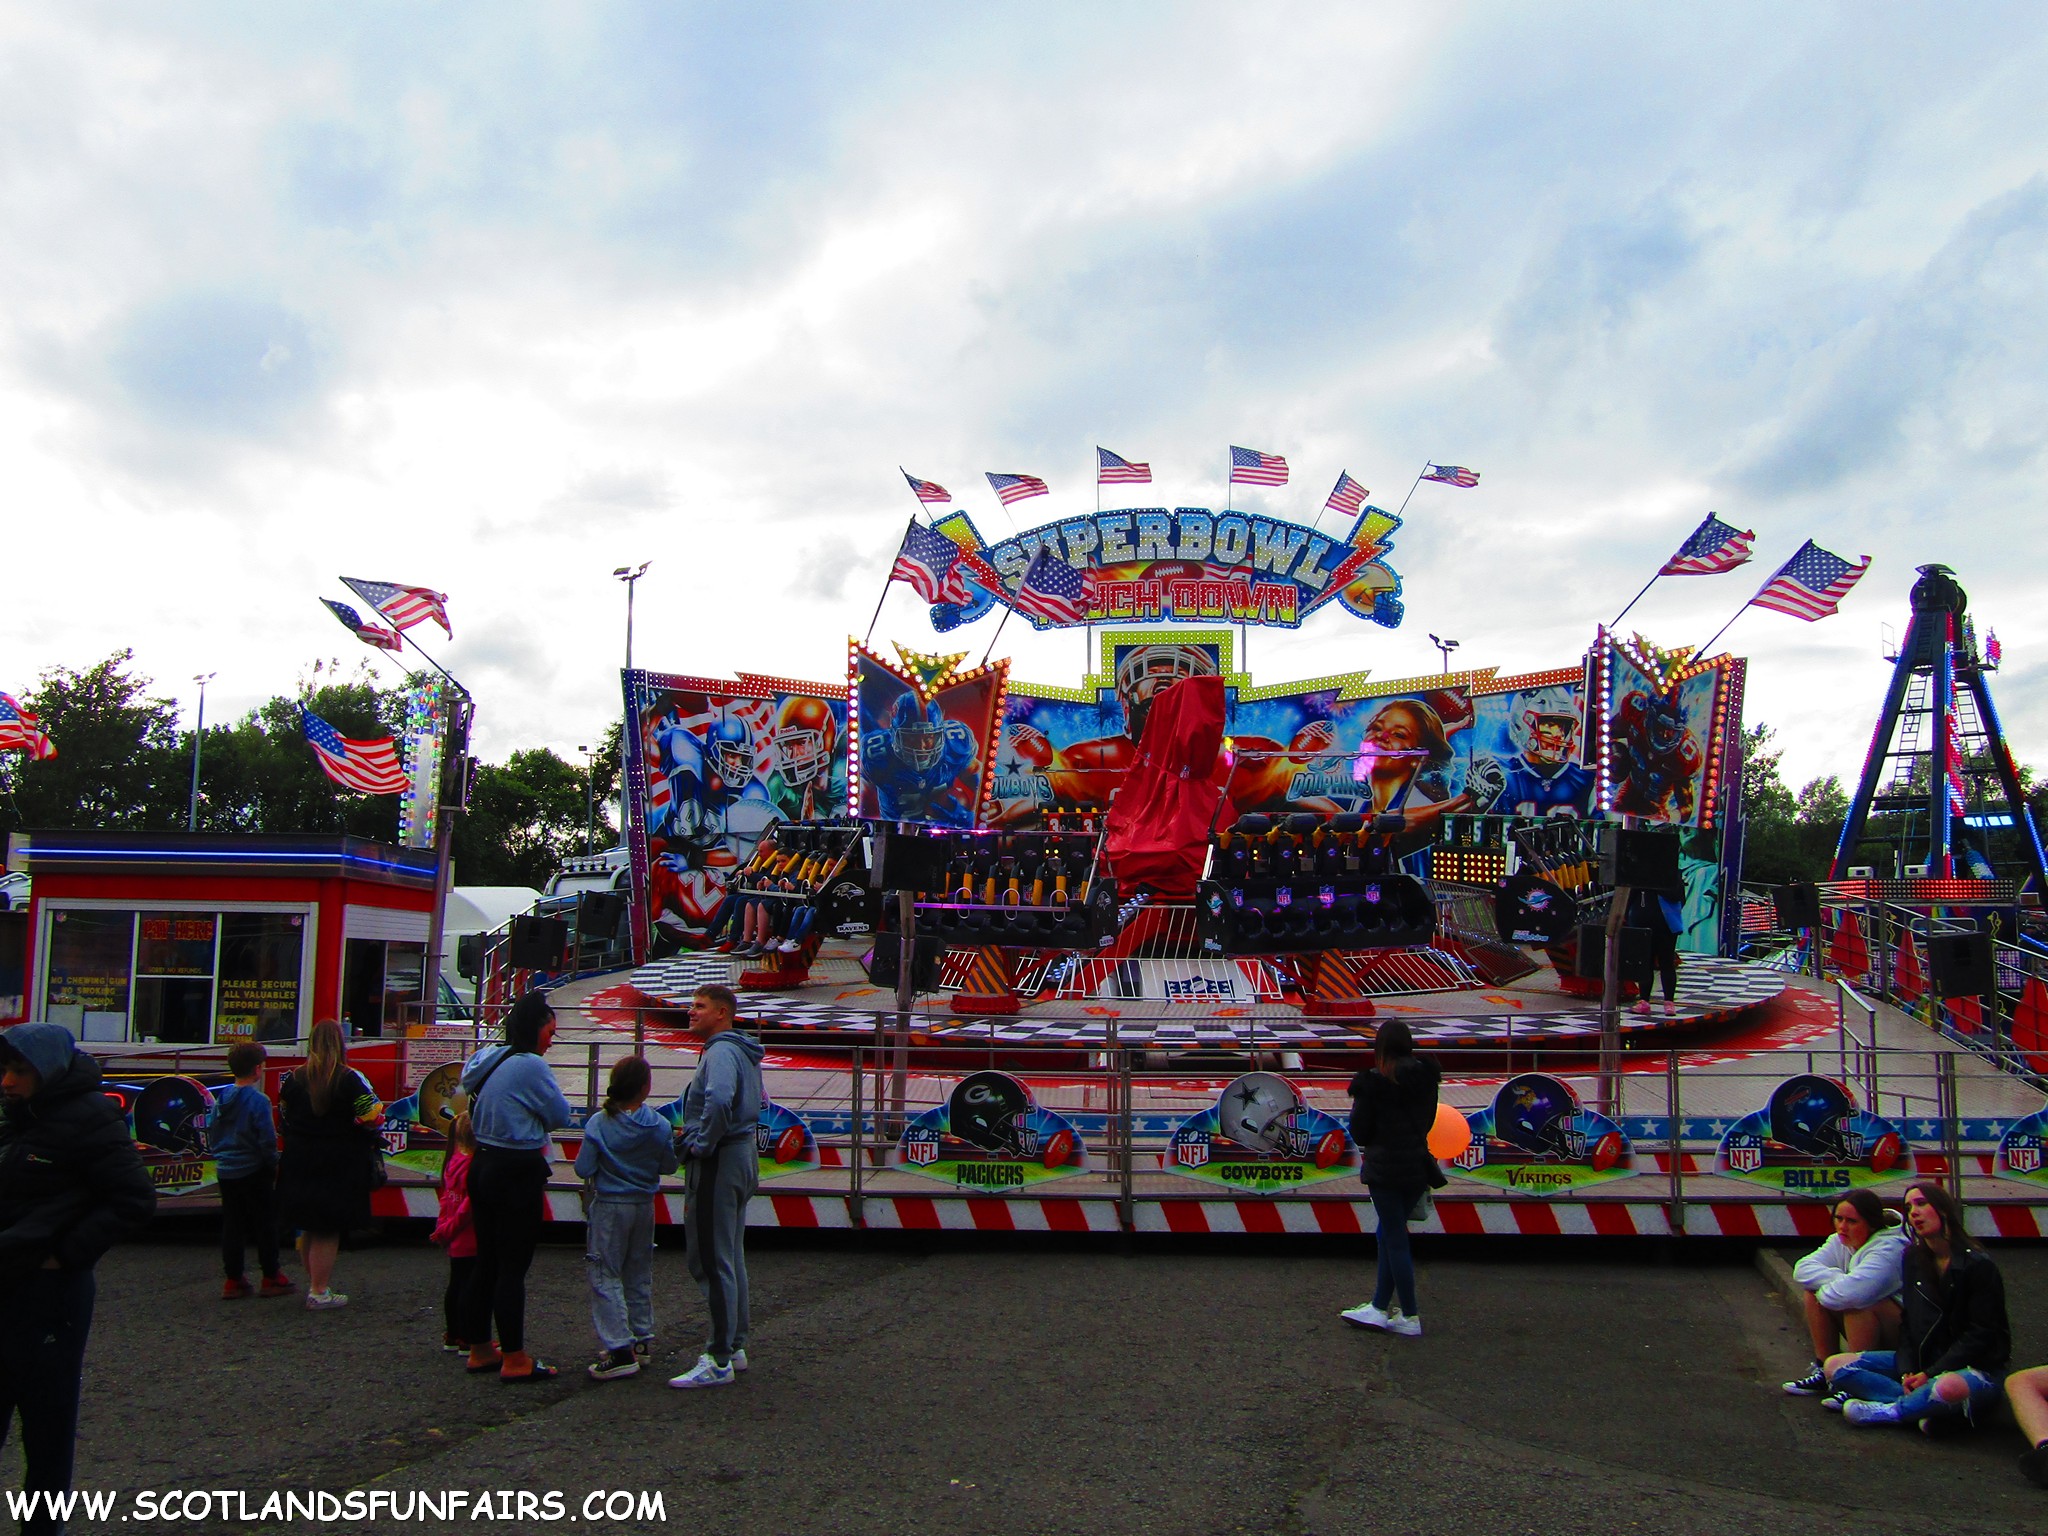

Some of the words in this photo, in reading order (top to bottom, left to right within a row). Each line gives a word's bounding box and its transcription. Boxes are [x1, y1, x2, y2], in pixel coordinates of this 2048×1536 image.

[1170, 580, 1299, 622] DOWN
[991, 775, 1053, 800] OWBOYS
[1293, 772, 1373, 800] DOLPHINS
[143, 919, 171, 940] PAY
[174, 919, 213, 941] HERE
[66, 976, 105, 984] CHEWING
[222, 980, 258, 988] PLEASE
[261, 980, 298, 989] SECURE
[77, 987, 116, 995] SMOKING
[223, 990, 240, 998] ALL
[244, 990, 296, 999] VALUABLES
[223, 1001, 260, 1009] BEFORE
[263, 1001, 295, 1009] RIDING
[217, 1024, 253, 1035] £4.00
[909, 1143, 937, 1162] NFL
[1179, 1145, 1207, 1163] NFL
[1455, 1147, 1483, 1166] NFL
[1731, 1149, 1760, 1168] NFL
[2010, 1149, 2039, 1170] NFL
[152, 1163, 204, 1183] GIANTS
[957, 1164, 1024, 1185] PACKERS
[1221, 1165, 1303, 1181] COWBOYS
[1783, 1169, 1850, 1188] BILLS
